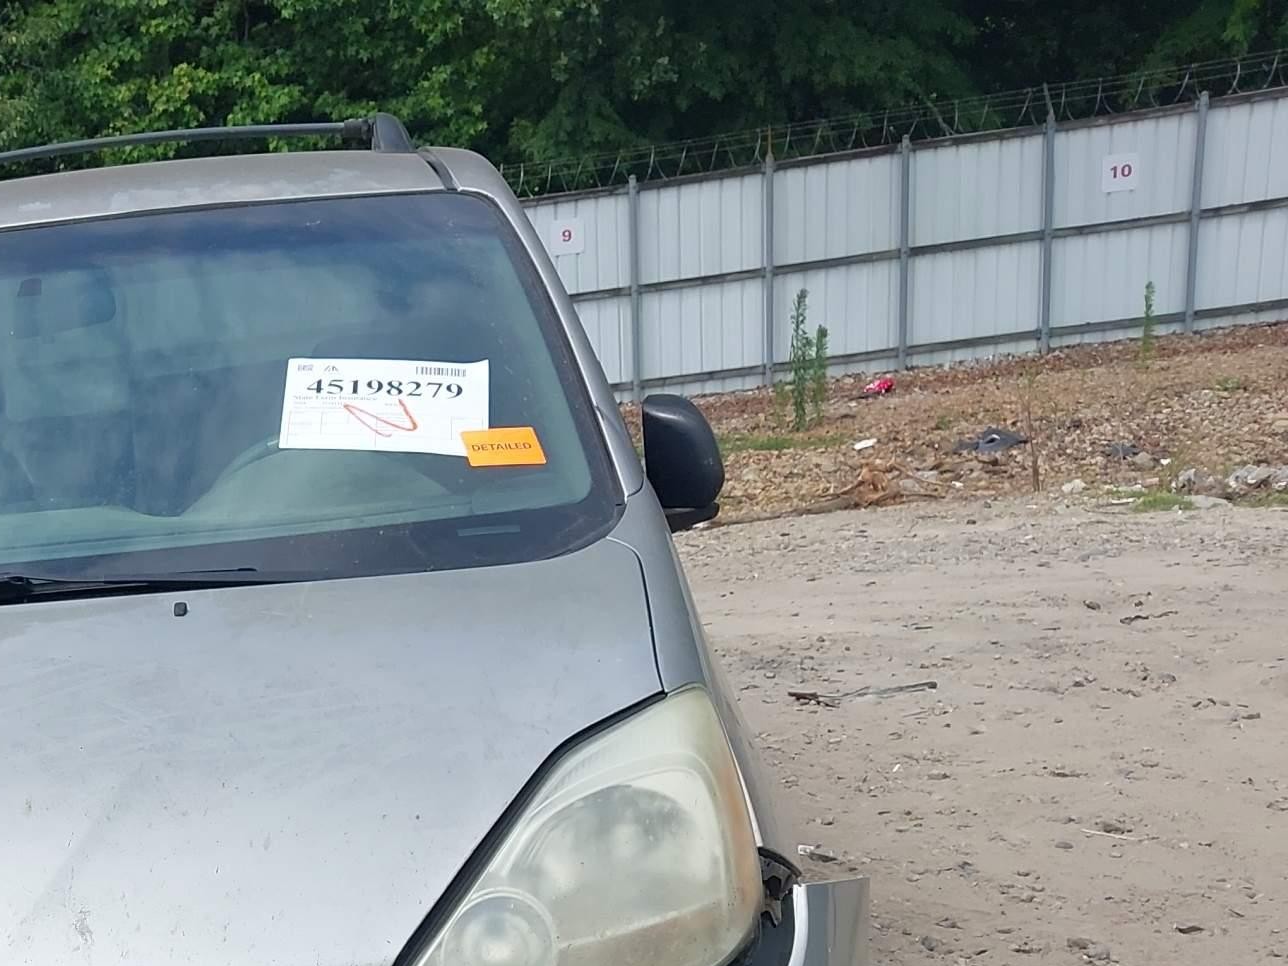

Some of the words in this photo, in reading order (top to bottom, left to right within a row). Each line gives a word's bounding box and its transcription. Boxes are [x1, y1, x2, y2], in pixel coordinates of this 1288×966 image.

[1110, 164, 1132, 179] 10
[562, 230, 572, 242] 9
[306, 378, 463, 400] 45198279
[471, 441, 532, 452] DETAILED
